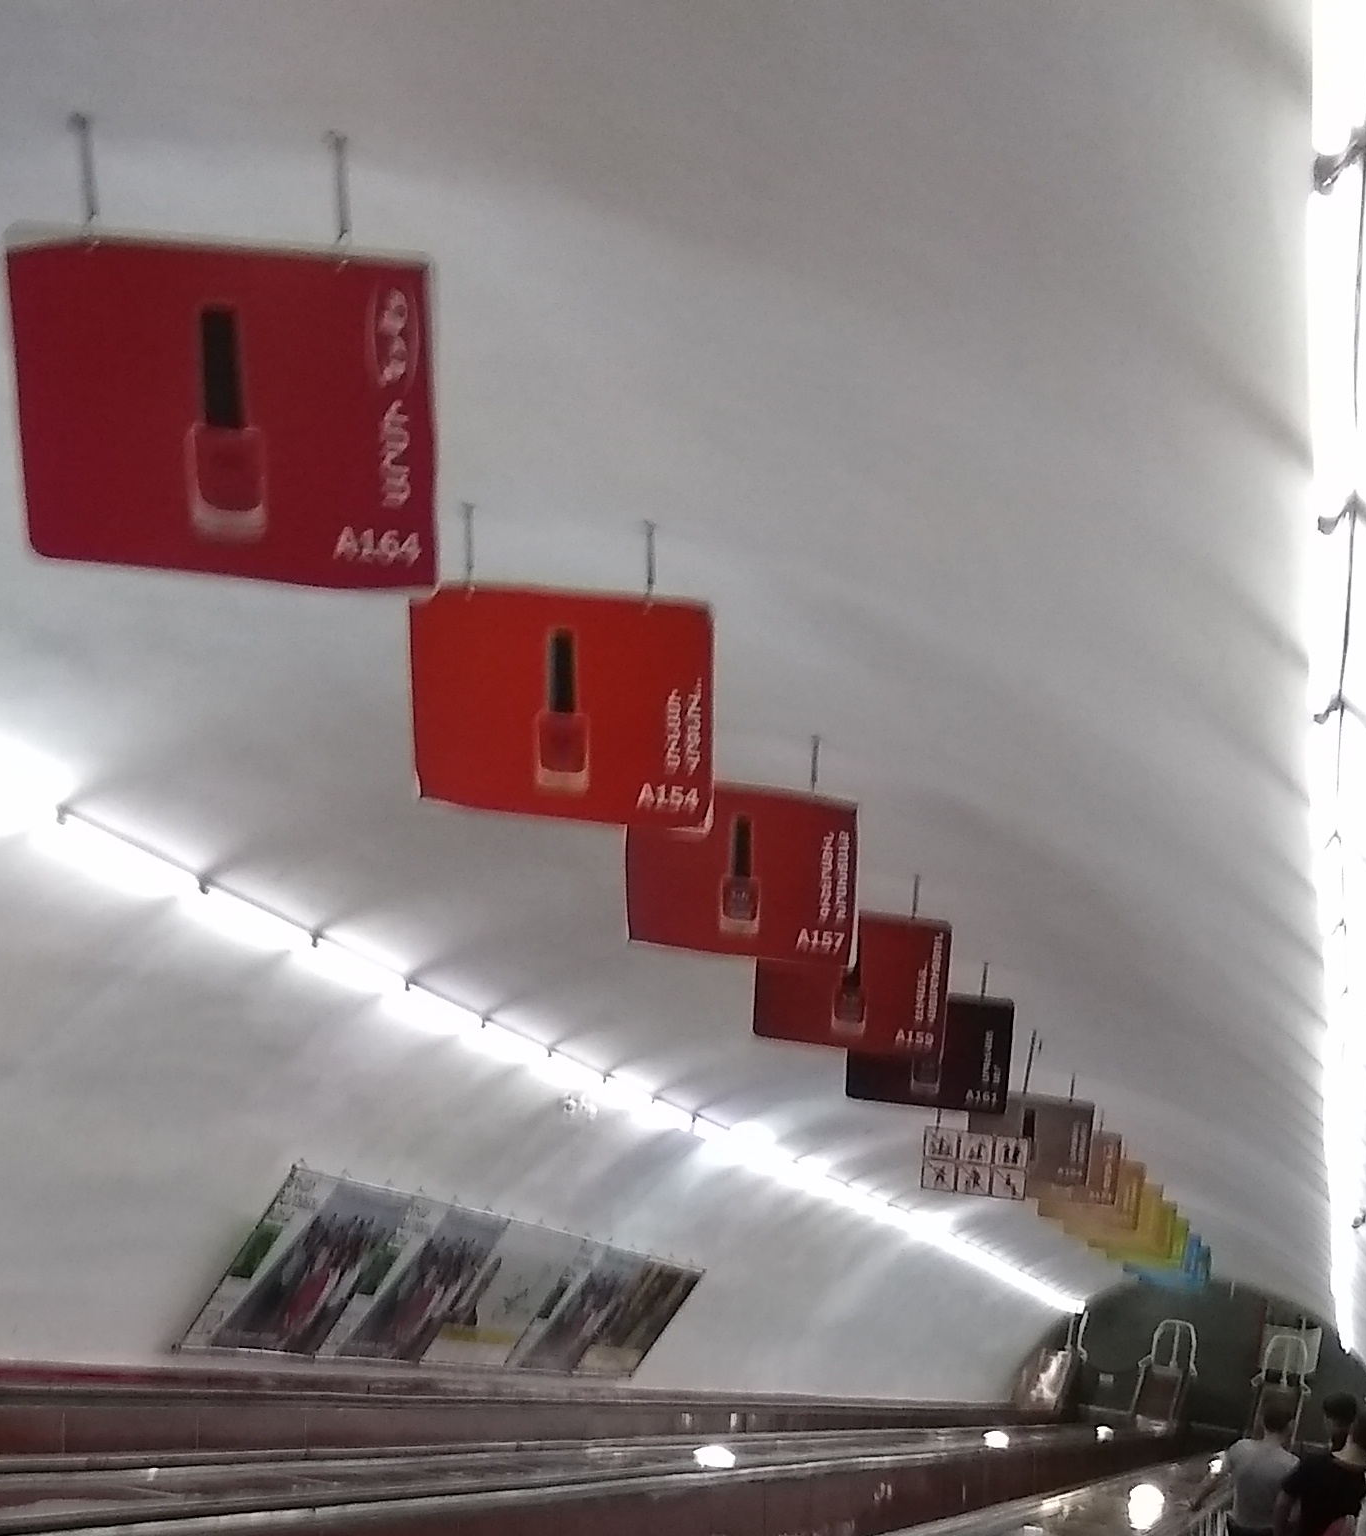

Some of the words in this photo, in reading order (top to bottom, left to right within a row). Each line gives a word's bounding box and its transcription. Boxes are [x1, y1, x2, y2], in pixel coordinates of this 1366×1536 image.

[333, 526, 422, 567] A164
[636, 782, 700, 812] A154
[796, 928, 845, 952] A157
[895, 1028, 934, 1048] A159
[965, 1088, 998, 1104] A161
